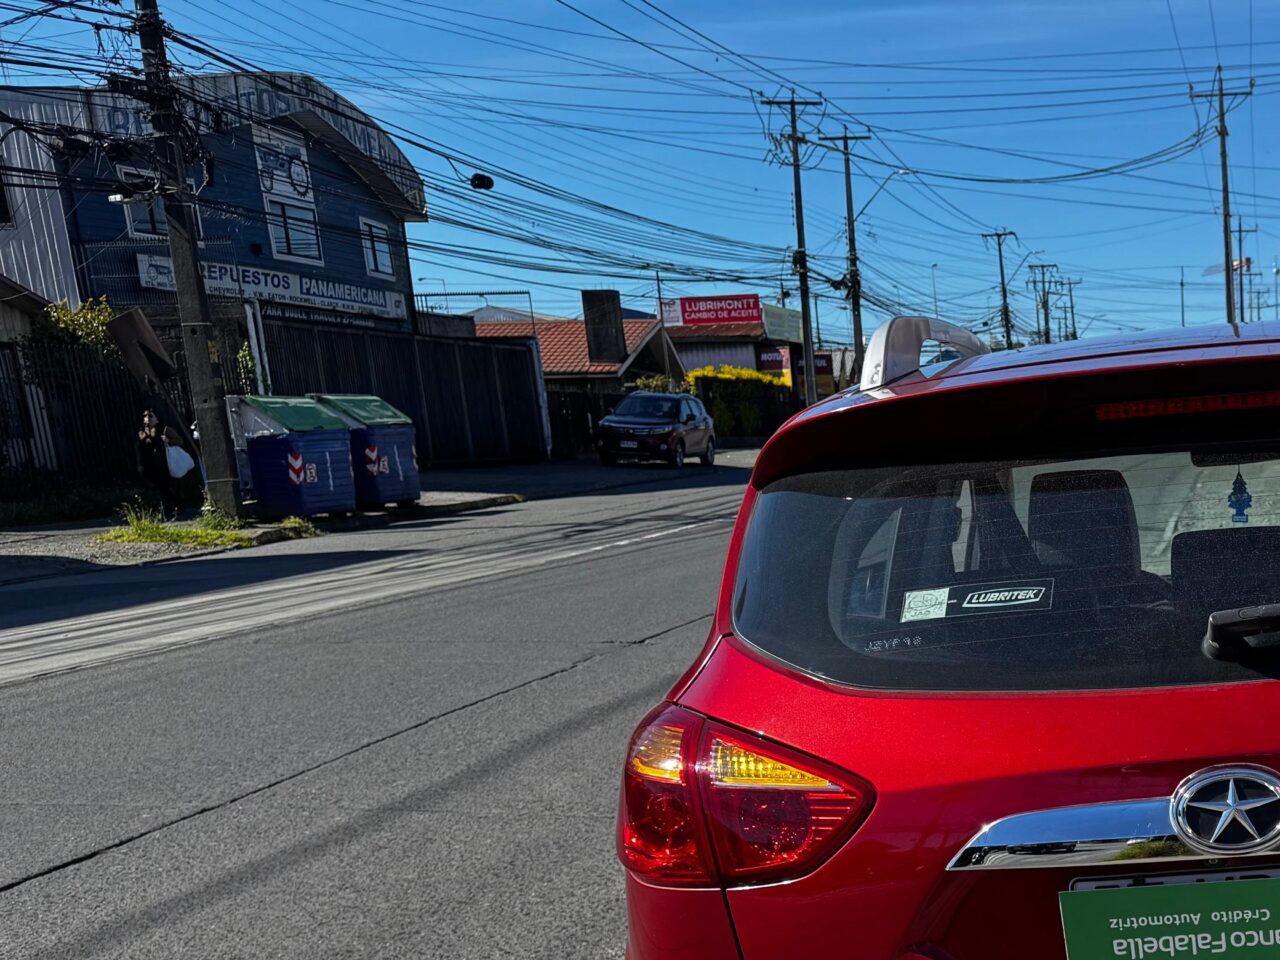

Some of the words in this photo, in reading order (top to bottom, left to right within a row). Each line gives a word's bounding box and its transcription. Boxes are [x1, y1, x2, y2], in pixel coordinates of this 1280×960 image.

[302, 276, 386, 306] PANAMERICANA
[685, 298, 756, 312] LUBRIMONTT
[684, 311, 717, 321] CAMBIO
[717, 311, 729, 319] DE
[730, 308, 758, 318] ACEITE
[798, 358, 828, 368] MTUL
[972, 589, 1039, 604] LUBRITEK
[1108, 912, 1201, 930] Automotriz
[1210, 908, 1271, 923] Crédito
